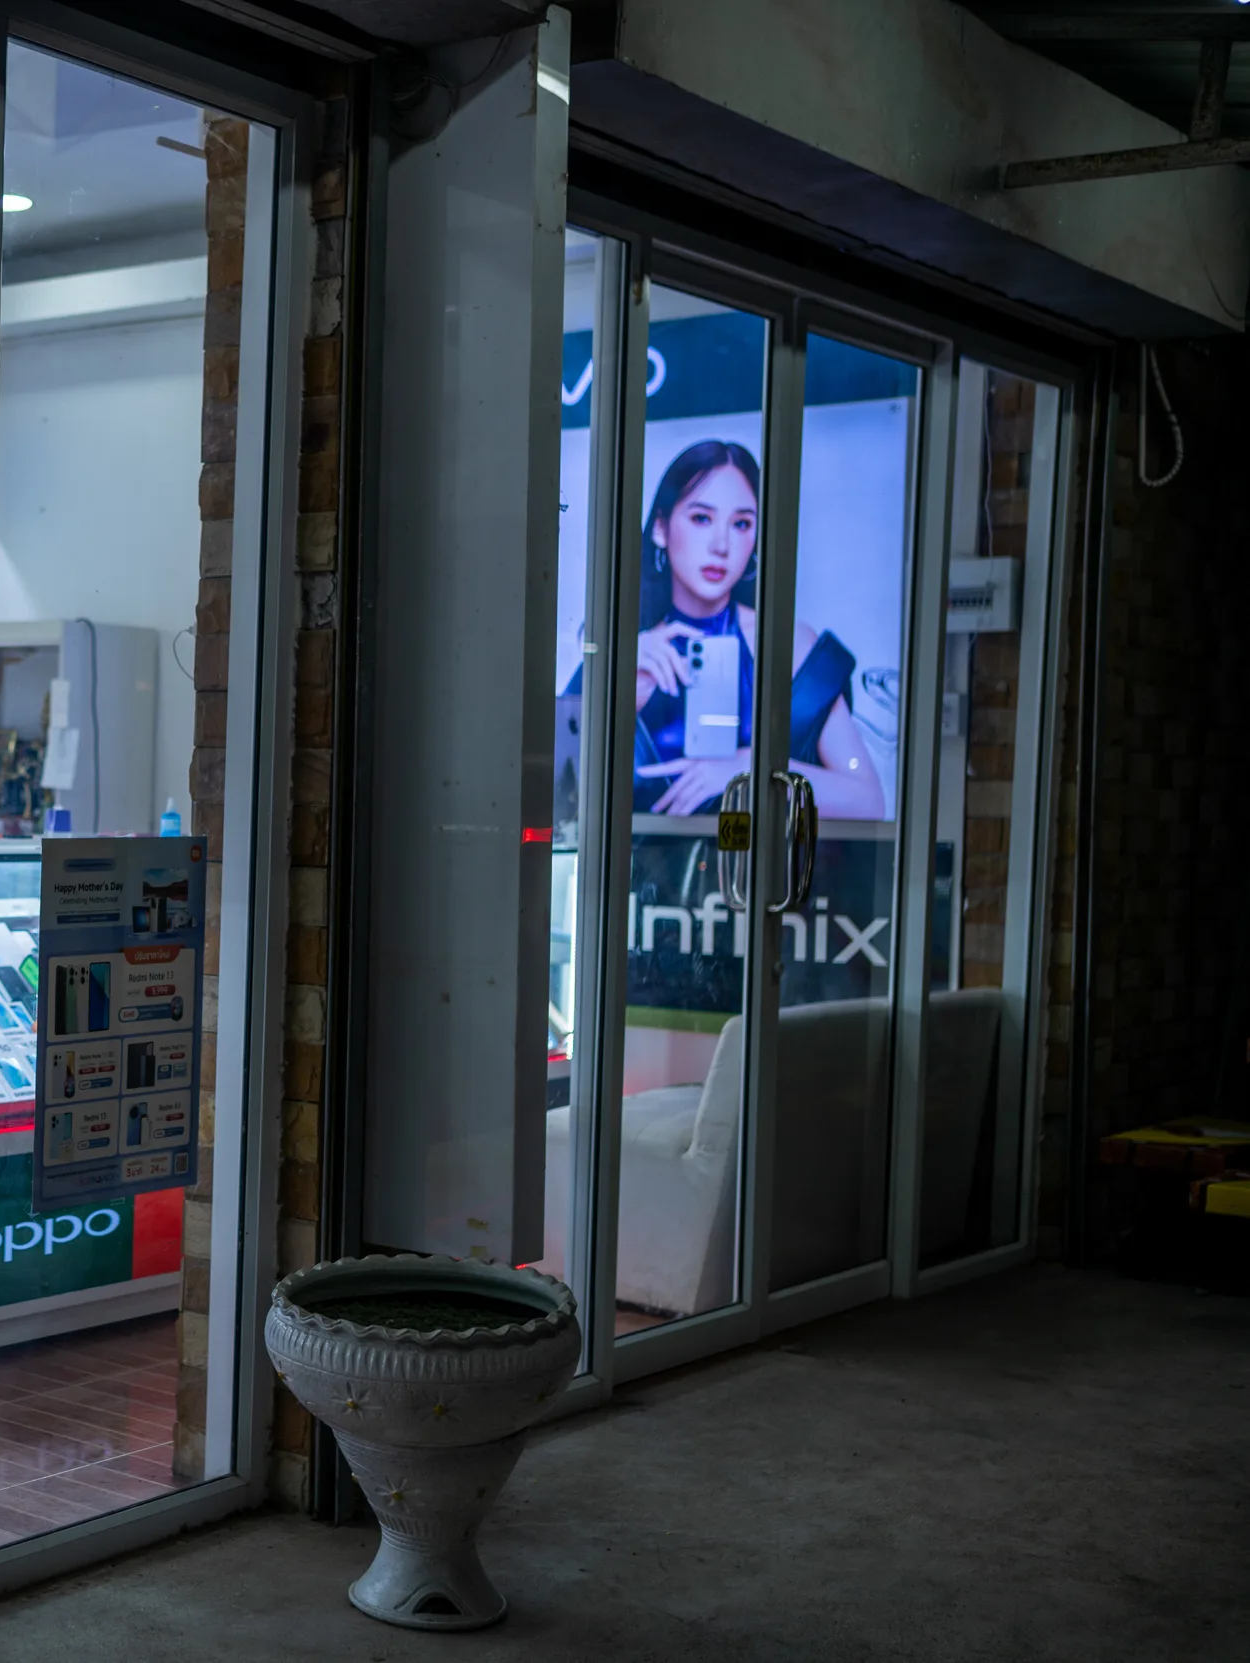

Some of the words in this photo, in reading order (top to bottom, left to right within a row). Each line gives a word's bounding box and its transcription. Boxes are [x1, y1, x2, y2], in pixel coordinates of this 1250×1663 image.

[54, 883, 77, 895] Happy
[78, 881, 109, 892] Mother's
[110, 881, 124, 892] Day
[59, 897, 88, 906] Celebrating
[128, 973, 148, 983] Redmi
[149, 972, 165, 981] Note
